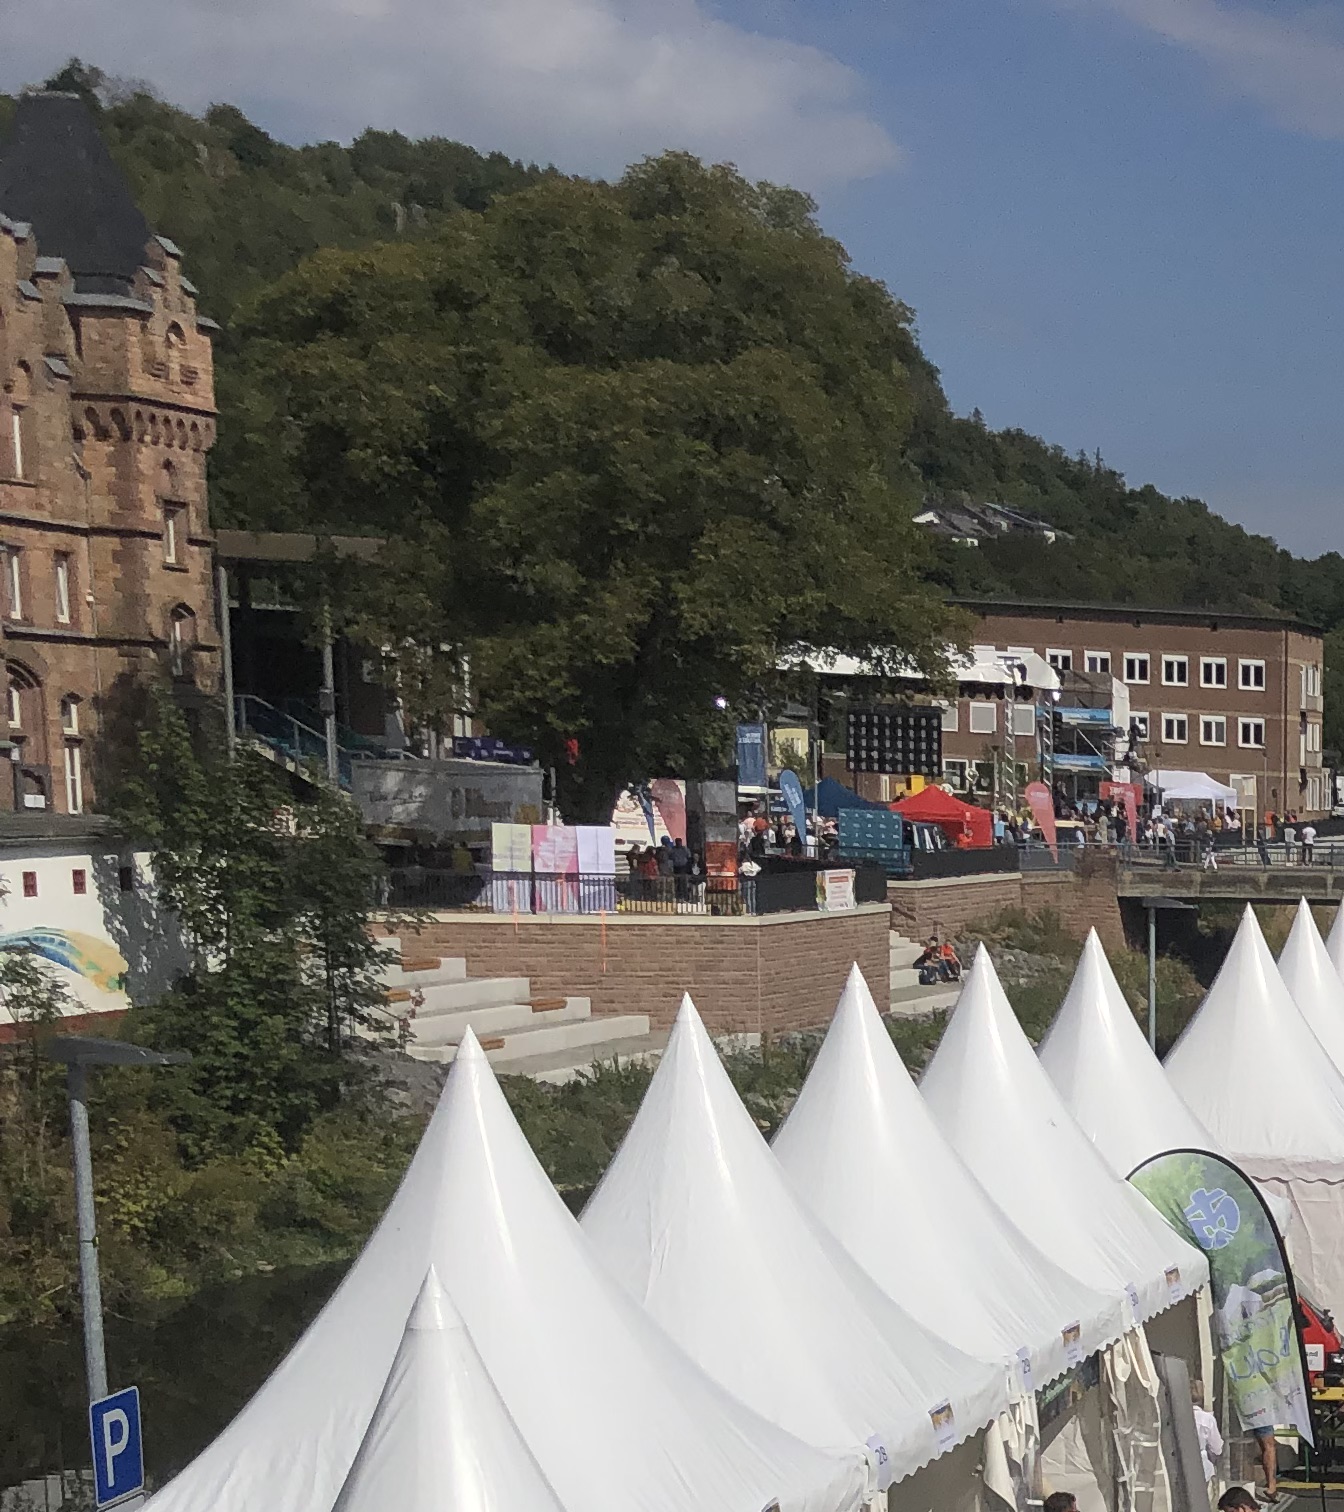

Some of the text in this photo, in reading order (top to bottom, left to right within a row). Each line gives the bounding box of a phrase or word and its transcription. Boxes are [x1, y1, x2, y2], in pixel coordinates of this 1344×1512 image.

[1022, 1357, 1031, 1375] 29
[102, 1407, 130, 1488] P
[874, 1445, 888, 1466] 28
